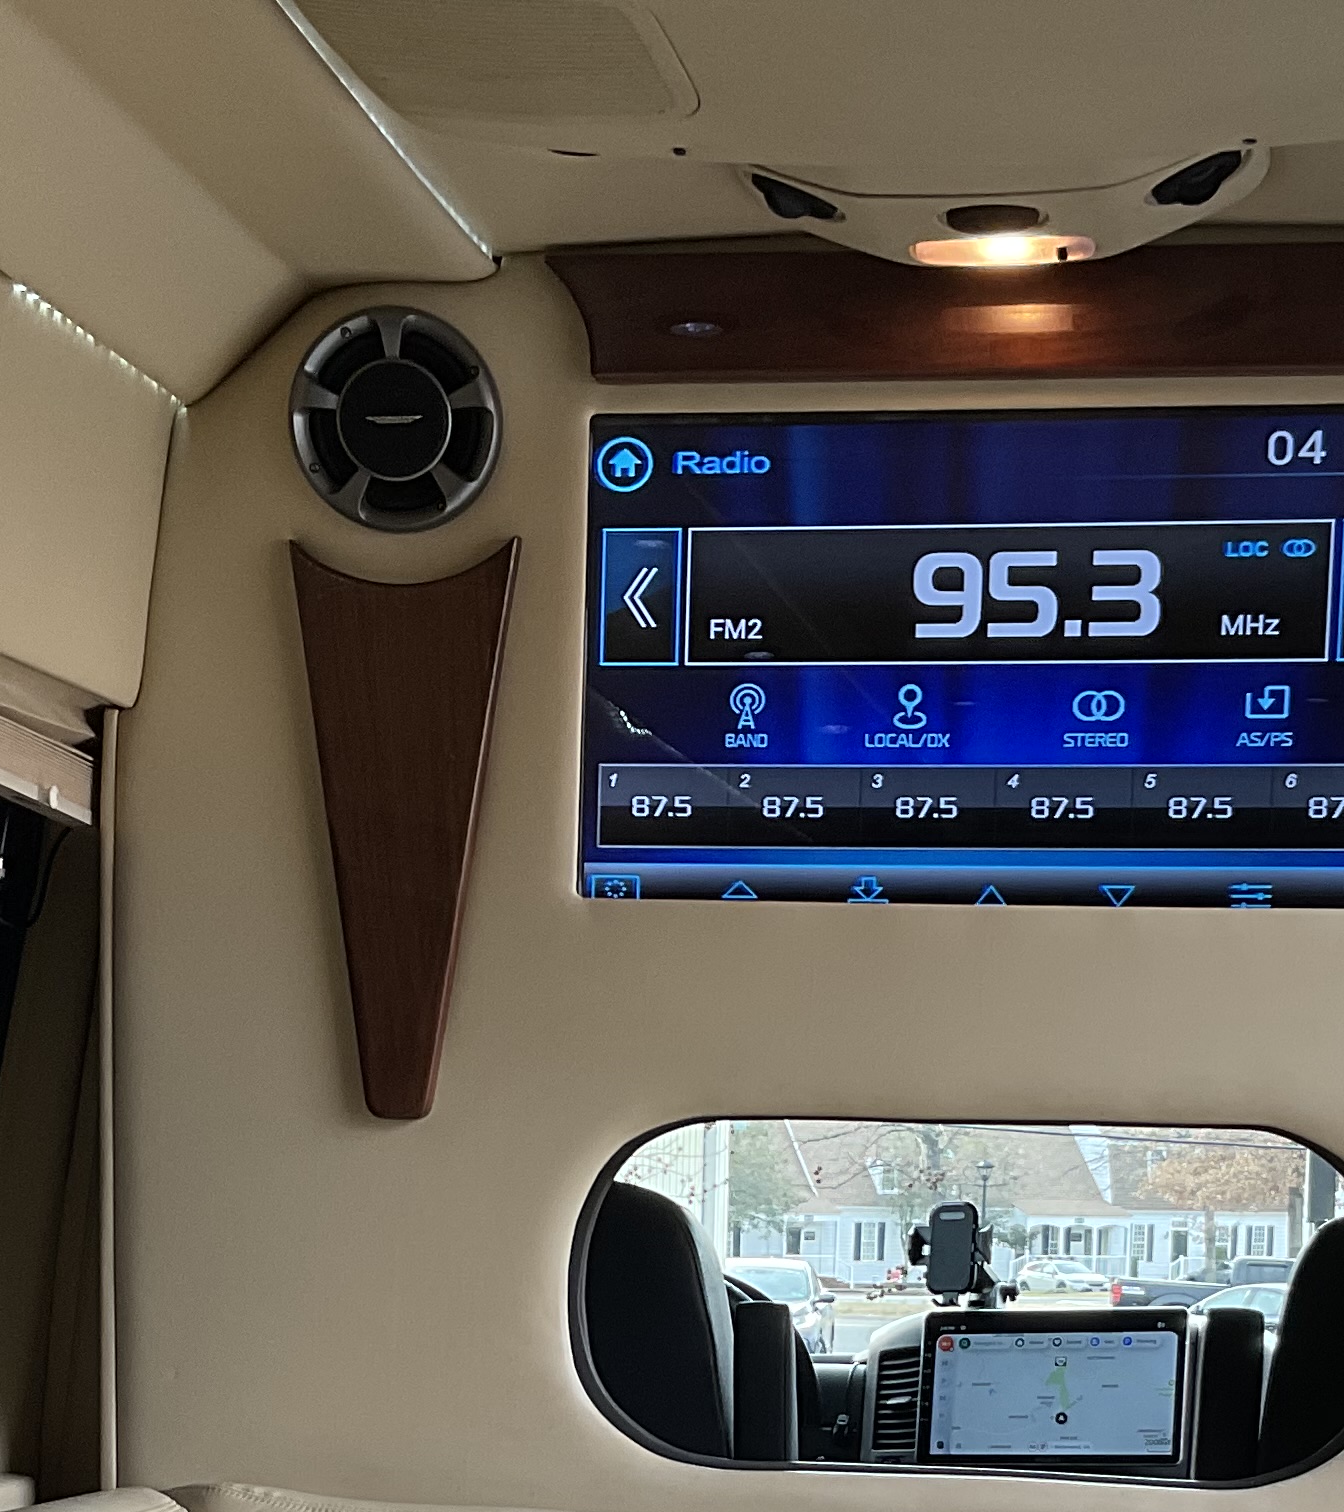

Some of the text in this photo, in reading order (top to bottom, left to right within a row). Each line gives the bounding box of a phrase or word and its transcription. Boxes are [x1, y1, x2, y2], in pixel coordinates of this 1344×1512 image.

[1267, 429, 1327, 466] 04
[676, 450, 771, 475] Radio
[1224, 540, 1269, 558] LOC
[913, 549, 1162, 639] 95.3
[709, 618, 763, 640] FM2
[1220, 613, 1281, 636] MHz
[724, 732, 769, 748] BAND
[864, 732, 951, 748] LOCAL/DX
[1062, 732, 1129, 748] STEREO
[1235, 731, 1294, 747] AS/PS
[609, 773, 618, 788] 1
[739, 773, 751, 788] 2
[871, 773, 884, 789] 3
[1007, 773, 1020, 789] 4
[1144, 773, 1158, 789] 5
[1285, 773, 1298, 788] 6
[631, 795, 692, 818] 87.5
[762, 796, 824, 819] 87.5
[895, 796, 958, 819] 87.5
[1030, 796, 1096, 819] 87.5
[1168, 796, 1233, 819] 87.5
